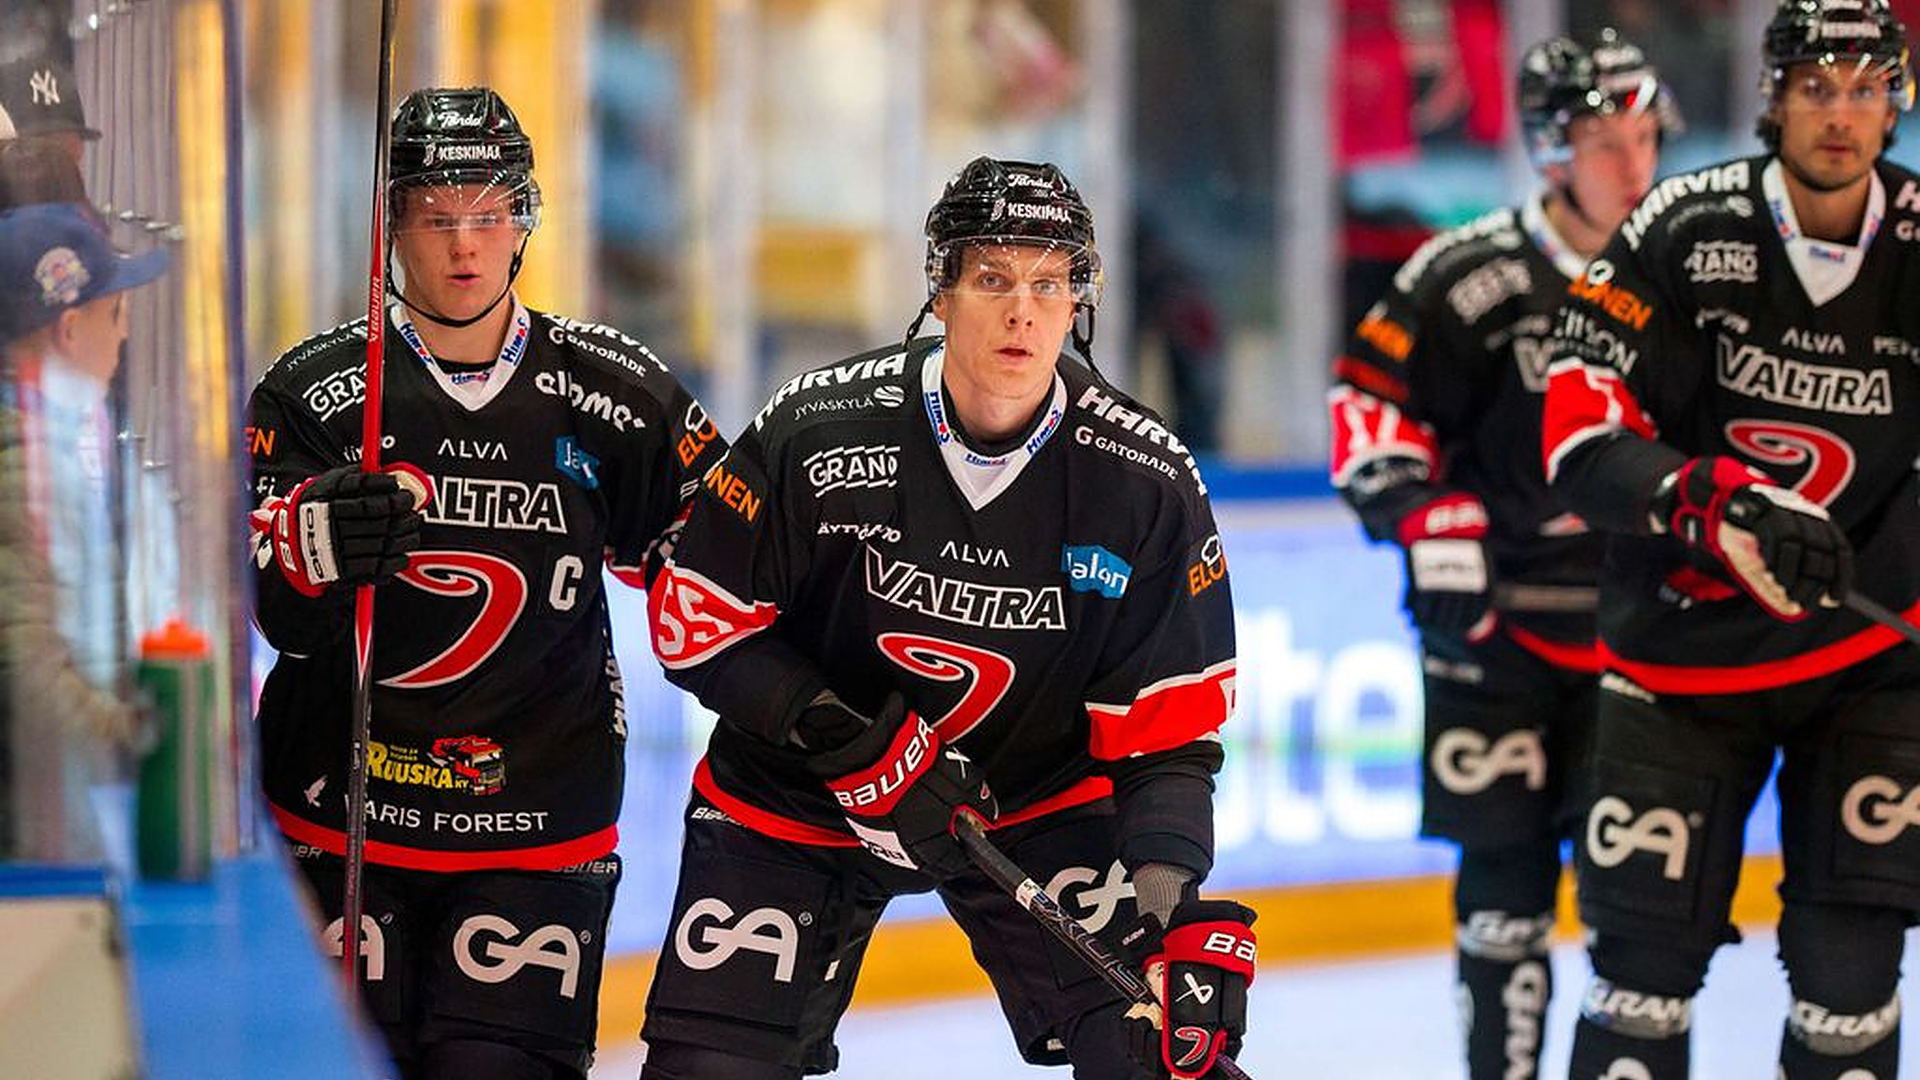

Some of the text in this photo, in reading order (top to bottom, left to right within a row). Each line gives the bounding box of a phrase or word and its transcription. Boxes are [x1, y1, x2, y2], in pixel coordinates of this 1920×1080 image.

[1621, 161, 1750, 251] HARVIA
[566, 334, 647, 377] GATORADE
[1780, 326, 1846, 356] ALVA
[1716, 332, 1893, 415] VALTRA
[436, 438, 509, 462] ALVA
[1094, 434, 1179, 481] GATORADE
[418, 475, 568, 535] ALTRA
[550, 556, 582, 611] C
[939, 540, 1010, 568] ALVA
[865, 542, 1067, 630] VALTRA
[1432, 726, 1547, 796] GA
[433, 811, 549, 833] FOREST
[1586, 795, 1690, 881] GA
[452, 913, 581, 999] GA
[676, 897, 798, 983] GA
